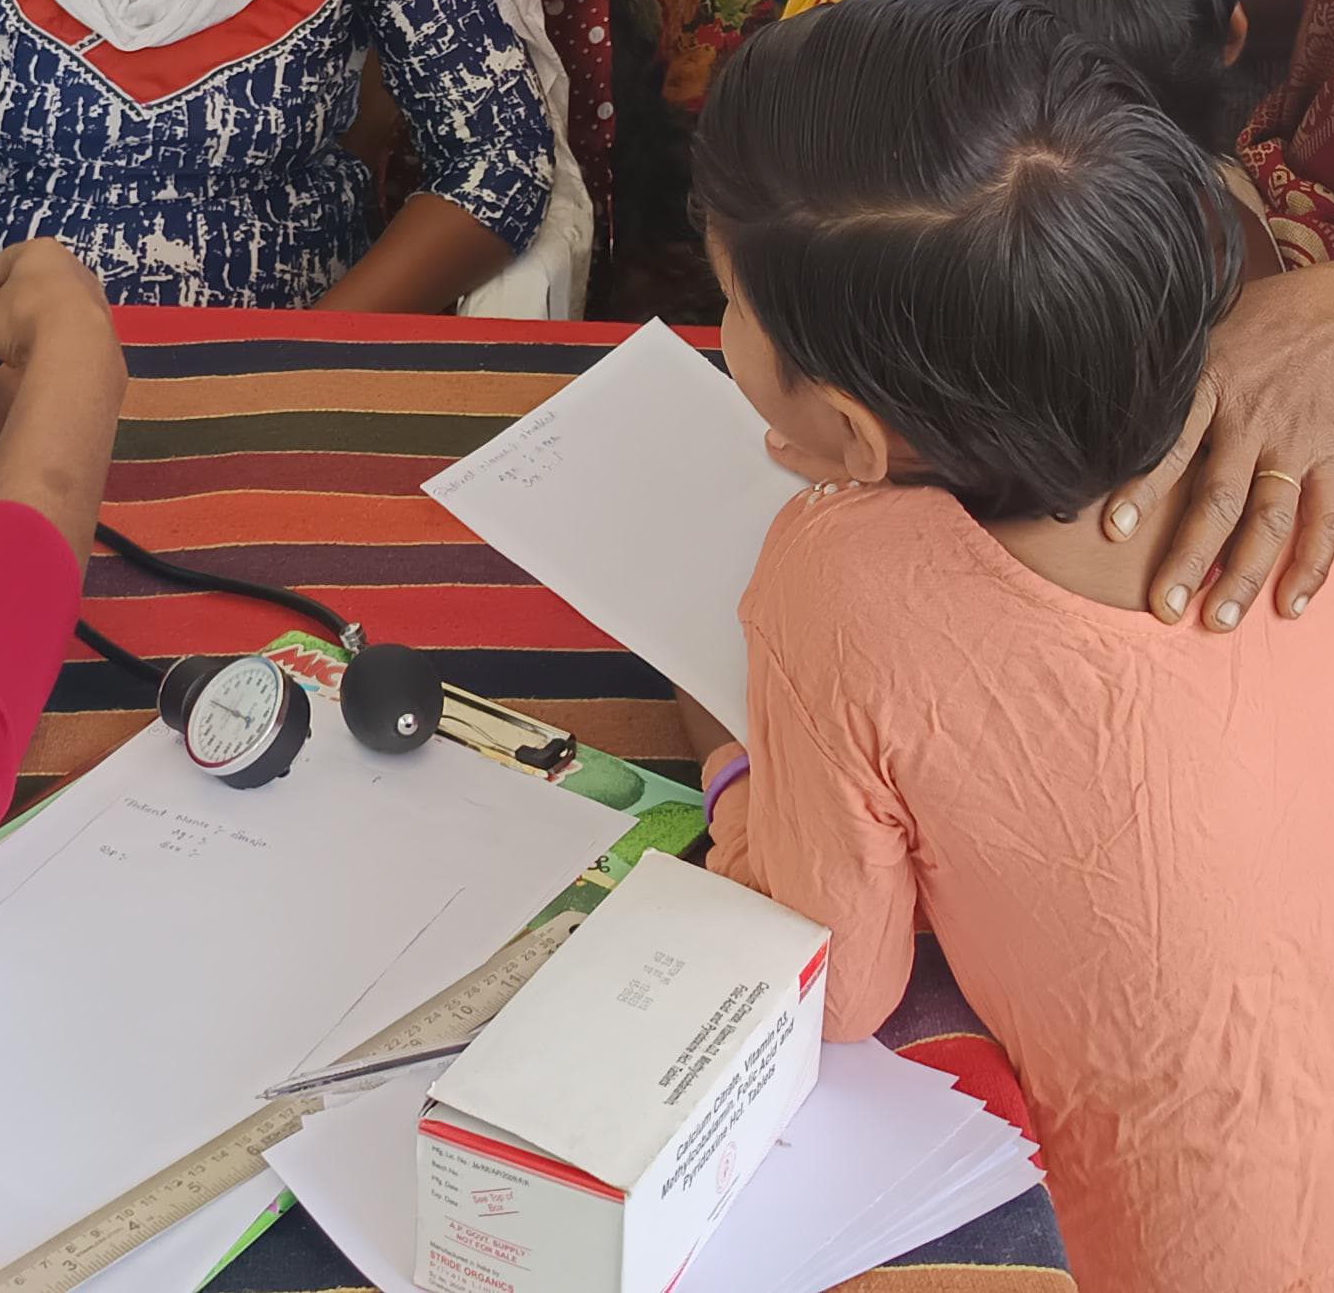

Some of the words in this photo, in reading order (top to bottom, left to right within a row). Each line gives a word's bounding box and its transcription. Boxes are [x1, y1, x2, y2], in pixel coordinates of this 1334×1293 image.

[384, 1037, 402, 1051] 22
[404, 1025, 422, 1038] 23
[423, 1011, 442, 1025] 24
[443, 998, 462, 1012] 25
[463, 985, 481, 999] 26
[482, 973, 499, 986] 27
[502, 961, 519, 974] 28
[521, 949, 537, 962] 29
[538, 937, 556, 950] 30
[452, 1005, 473, 1021] 10
[500, 972, 521, 988] 11
[676, 1111, 712, 1161] Calcium
[744, 1030, 775, 1072] Vitamin
[736, 1070, 758, 1101] Folic
[758, 1041, 778, 1075] Acid
[779, 1016, 795, 1046] and
[682, 1127, 728, 1191] Pyridoxine
[747, 1063, 776, 1105] Tablets
[62, 1259, 78, 1272] 3
[128, 1220, 141, 1233] 4
[189, 1182, 203, 1194] 5
[246, 1144, 260, 1157] 6
[456, 1233, 473, 1246] NOT
[475, 1241, 493, 1254] FOR
[494, 1249, 519, 1263] SALE
[493, 1239, 526, 1257] SUPPLY
[430, 1249, 462, 1272] STRIDE
[464, 1266, 515, 1293] ORGANICS
